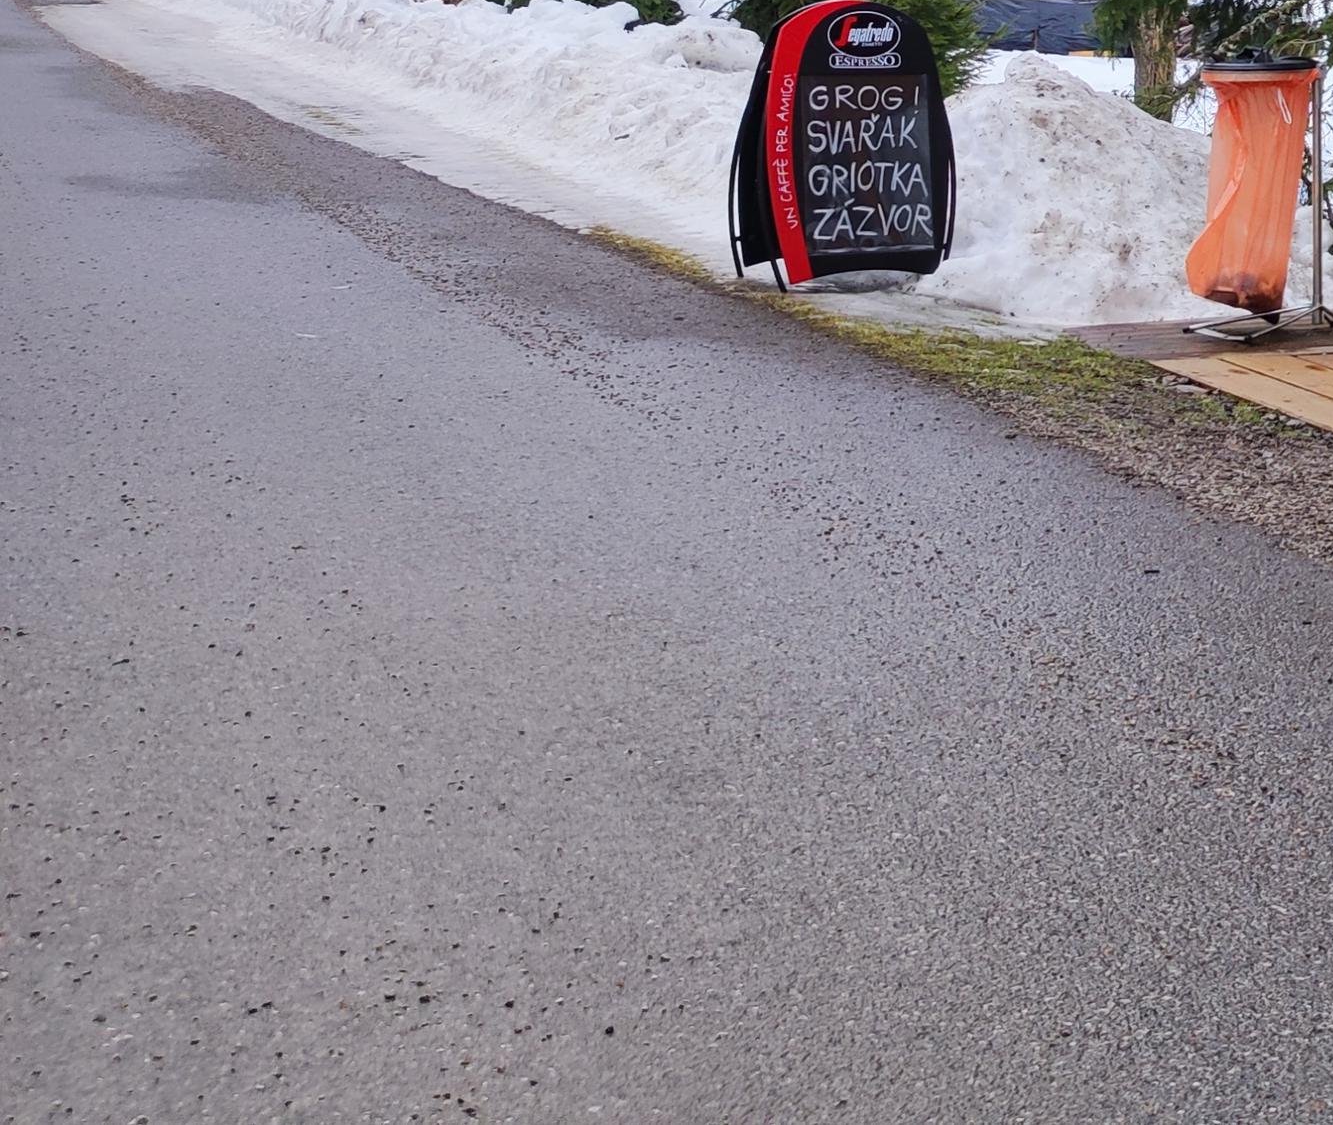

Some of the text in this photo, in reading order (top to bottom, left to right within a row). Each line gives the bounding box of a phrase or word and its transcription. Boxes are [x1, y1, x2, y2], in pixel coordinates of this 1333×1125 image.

[835, 16, 894, 47] Segafredo
[835, 55, 895, 67] ESPRESSO
[809, 86, 904, 111] GROG
[776, 125, 789, 152] PER
[772, 157, 793, 203] CAFFÈ
[808, 162, 928, 197] GRIOTKA
[783, 207, 799, 230] UN
[812, 198, 934, 241] ZÁZVOR
